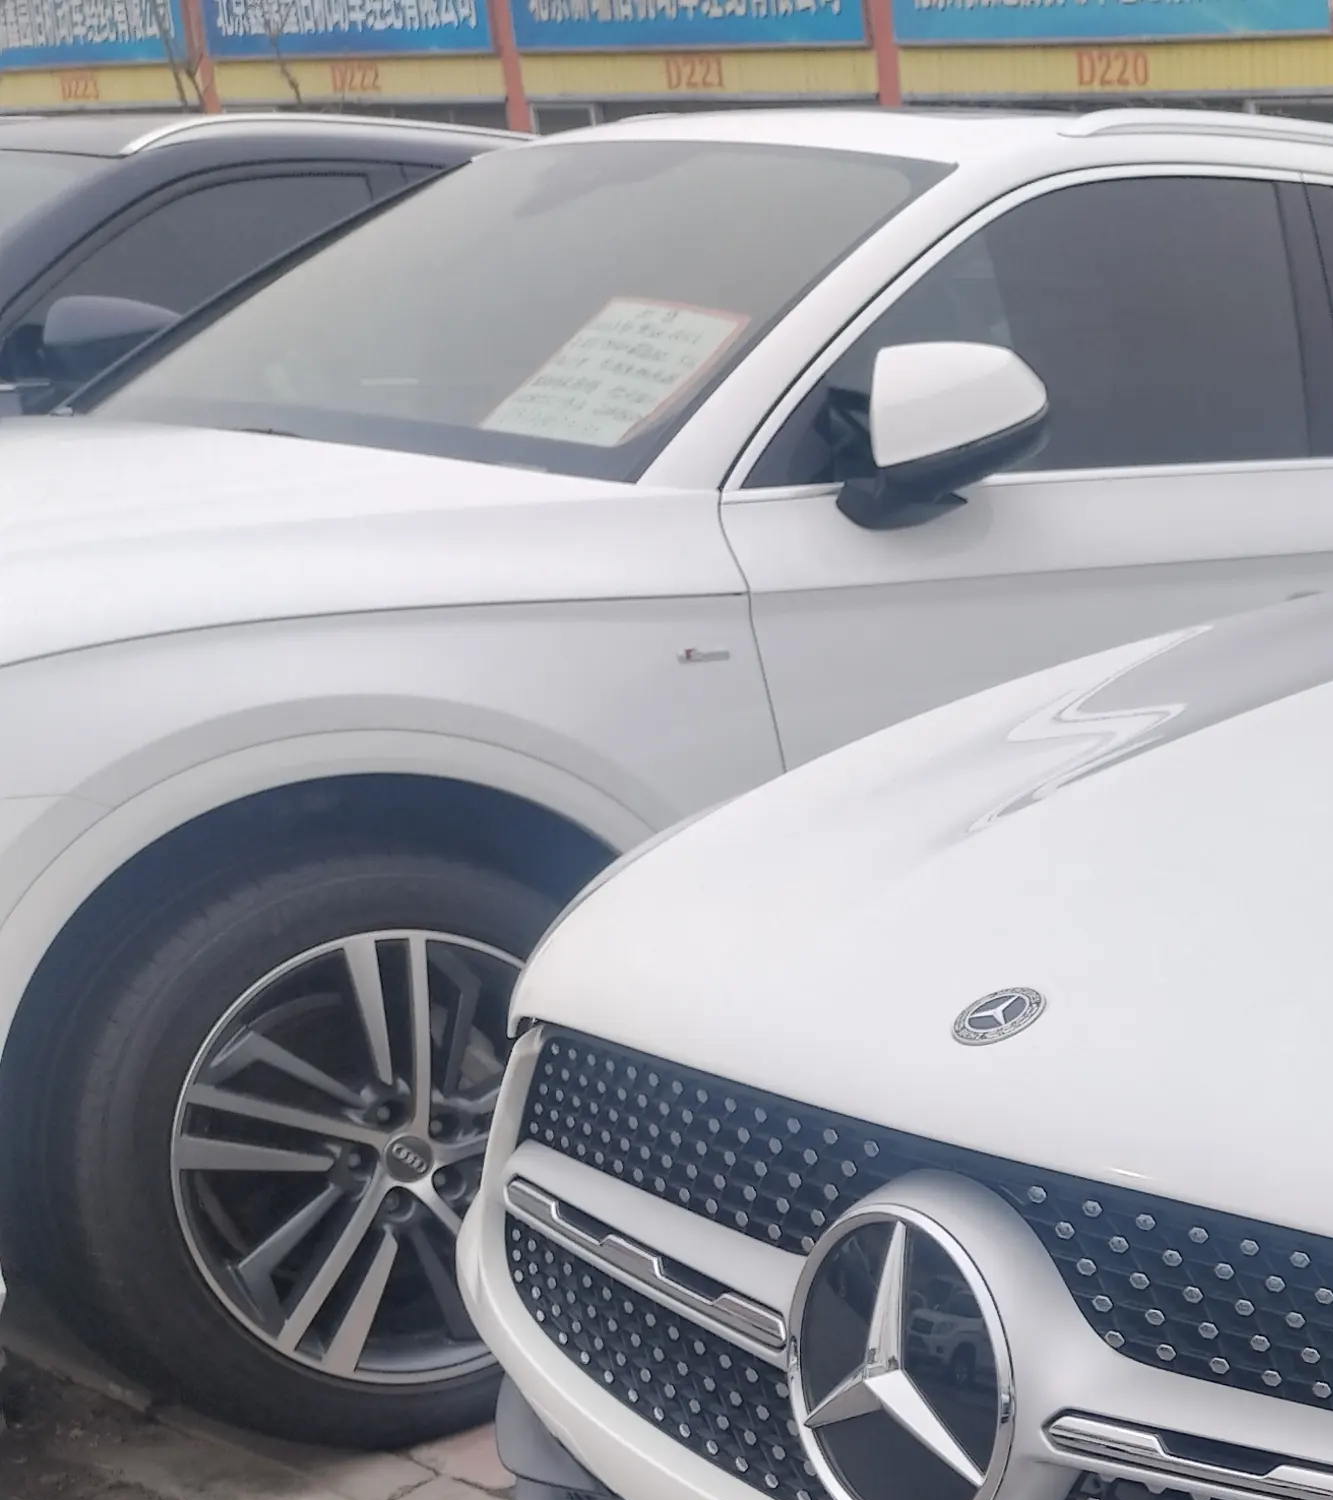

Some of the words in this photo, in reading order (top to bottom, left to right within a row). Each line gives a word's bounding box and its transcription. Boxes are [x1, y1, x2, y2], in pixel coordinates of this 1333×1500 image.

[330, 61, 381, 93] D222
[663, 55, 724, 90] D221
[1076, 51, 1149, 87] D220
